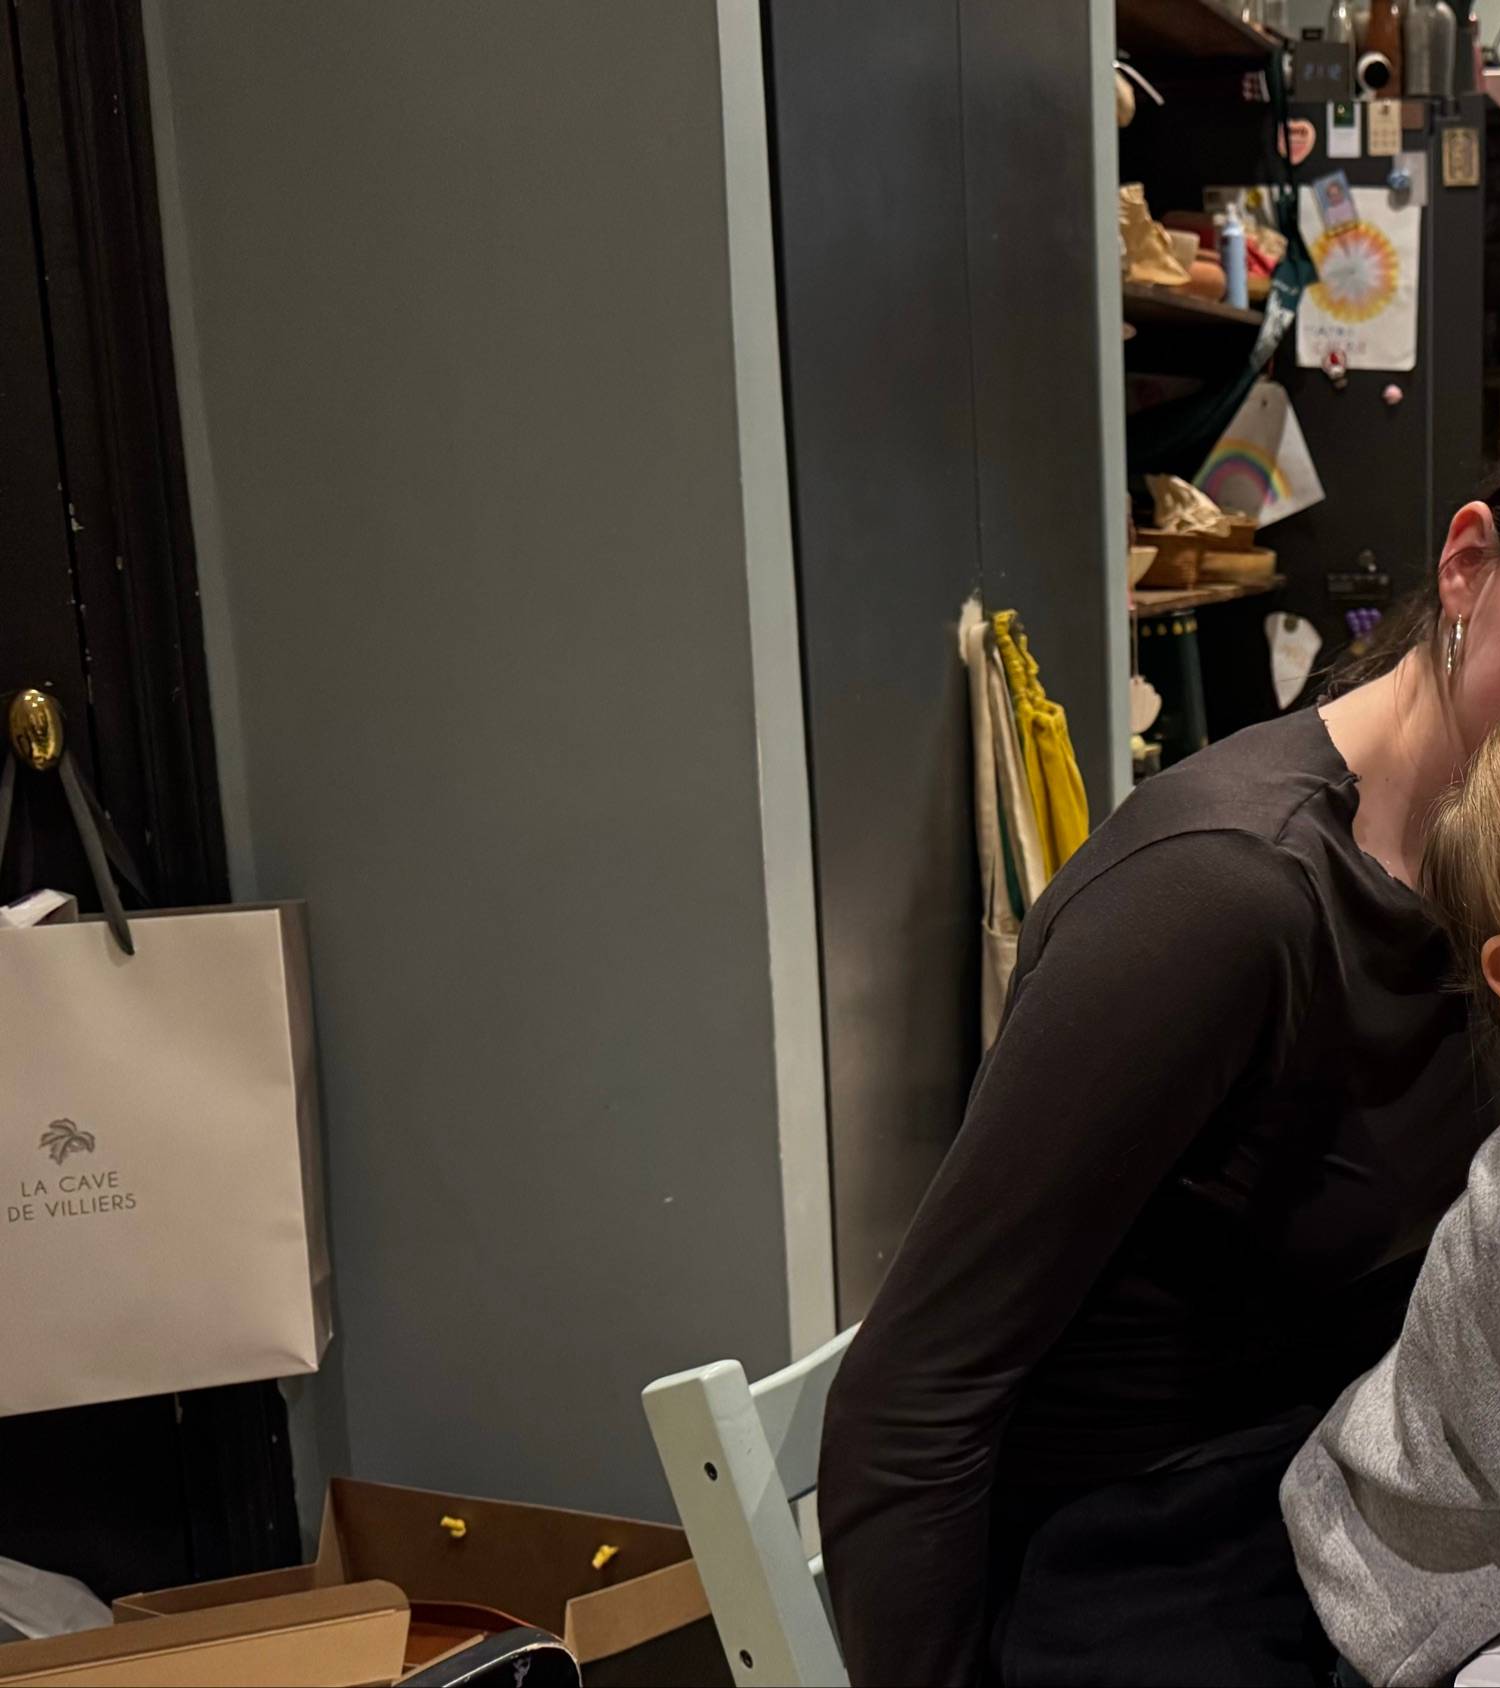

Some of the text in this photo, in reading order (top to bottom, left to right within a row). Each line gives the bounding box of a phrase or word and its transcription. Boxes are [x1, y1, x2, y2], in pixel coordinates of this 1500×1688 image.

[20, 1171, 119, 1198] LA CAVE
[7, 1193, 137, 1223] DE VILLIERS
